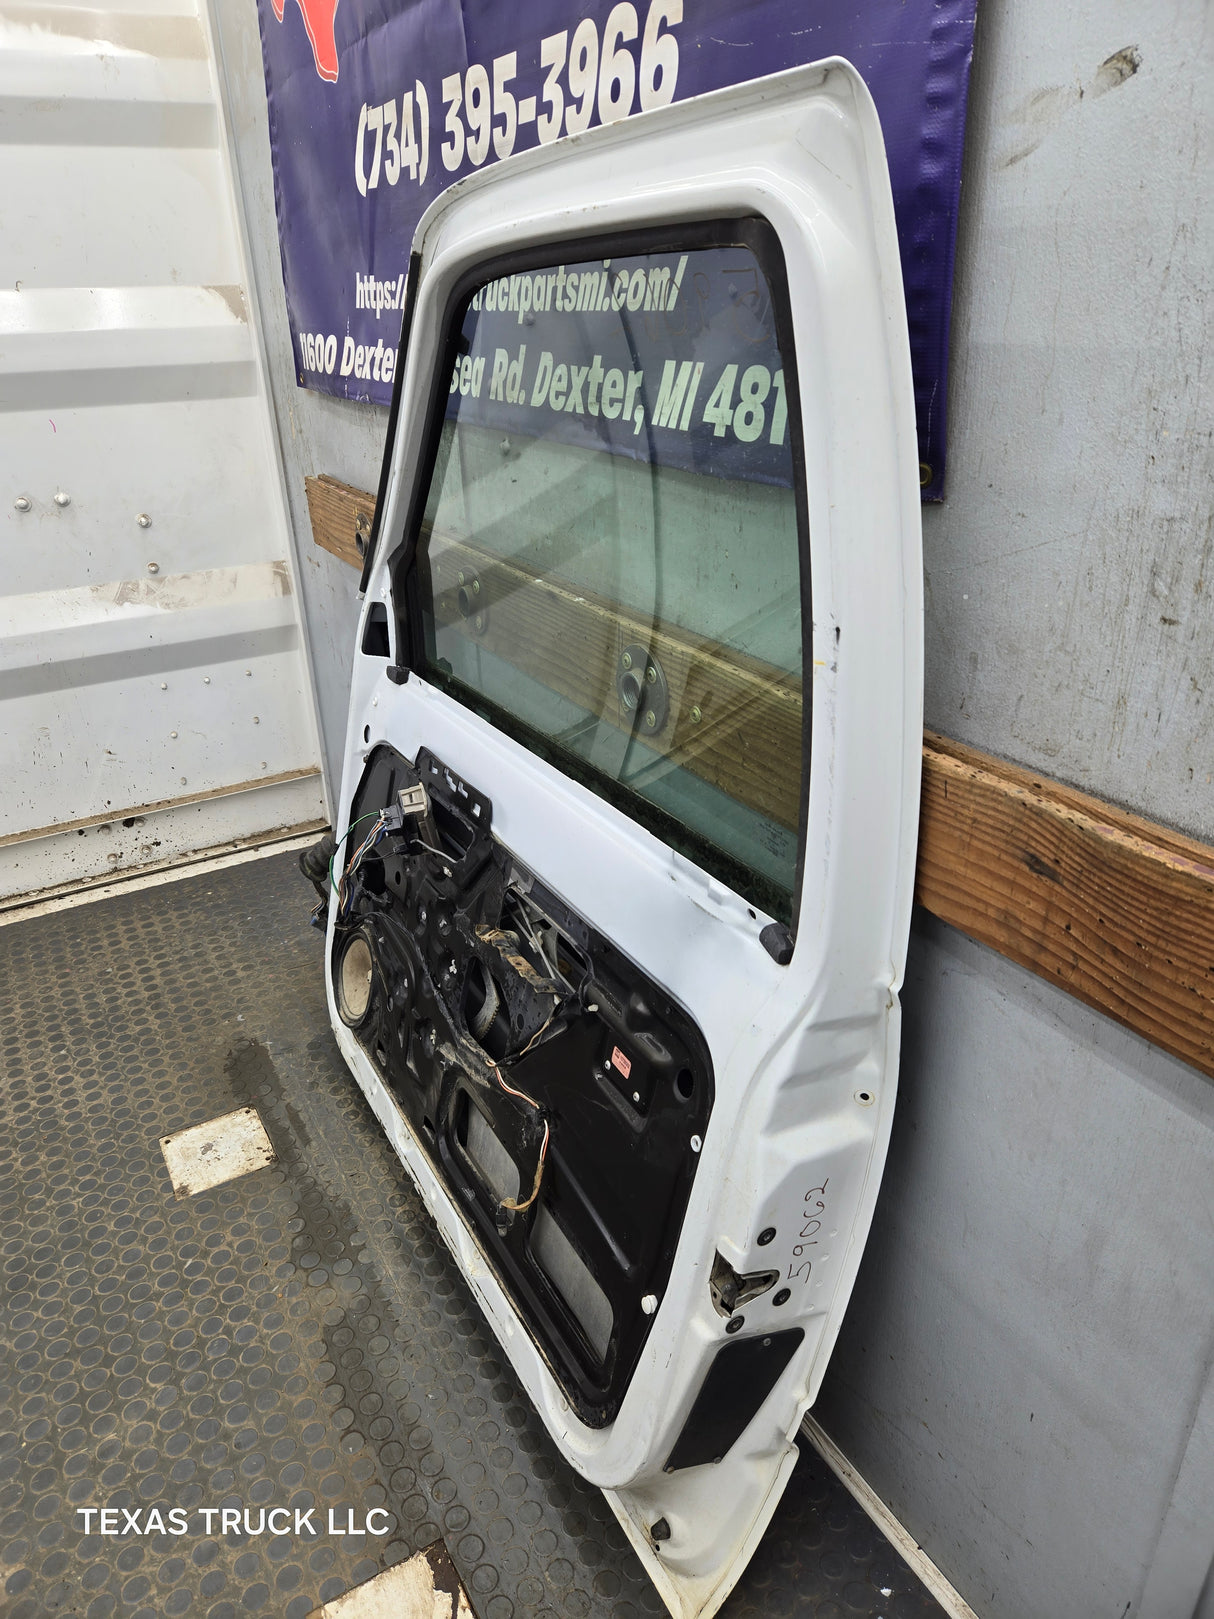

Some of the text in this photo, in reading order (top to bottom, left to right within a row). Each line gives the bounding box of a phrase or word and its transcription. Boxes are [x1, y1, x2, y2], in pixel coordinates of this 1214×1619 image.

[355, 0, 684, 197] (734) 395-3966
[299, 332, 338, 375] 11600
[489, 344, 527, 405] Rd.
[530, 352, 645, 435] Dexter,
[651, 359, 705, 431] MI
